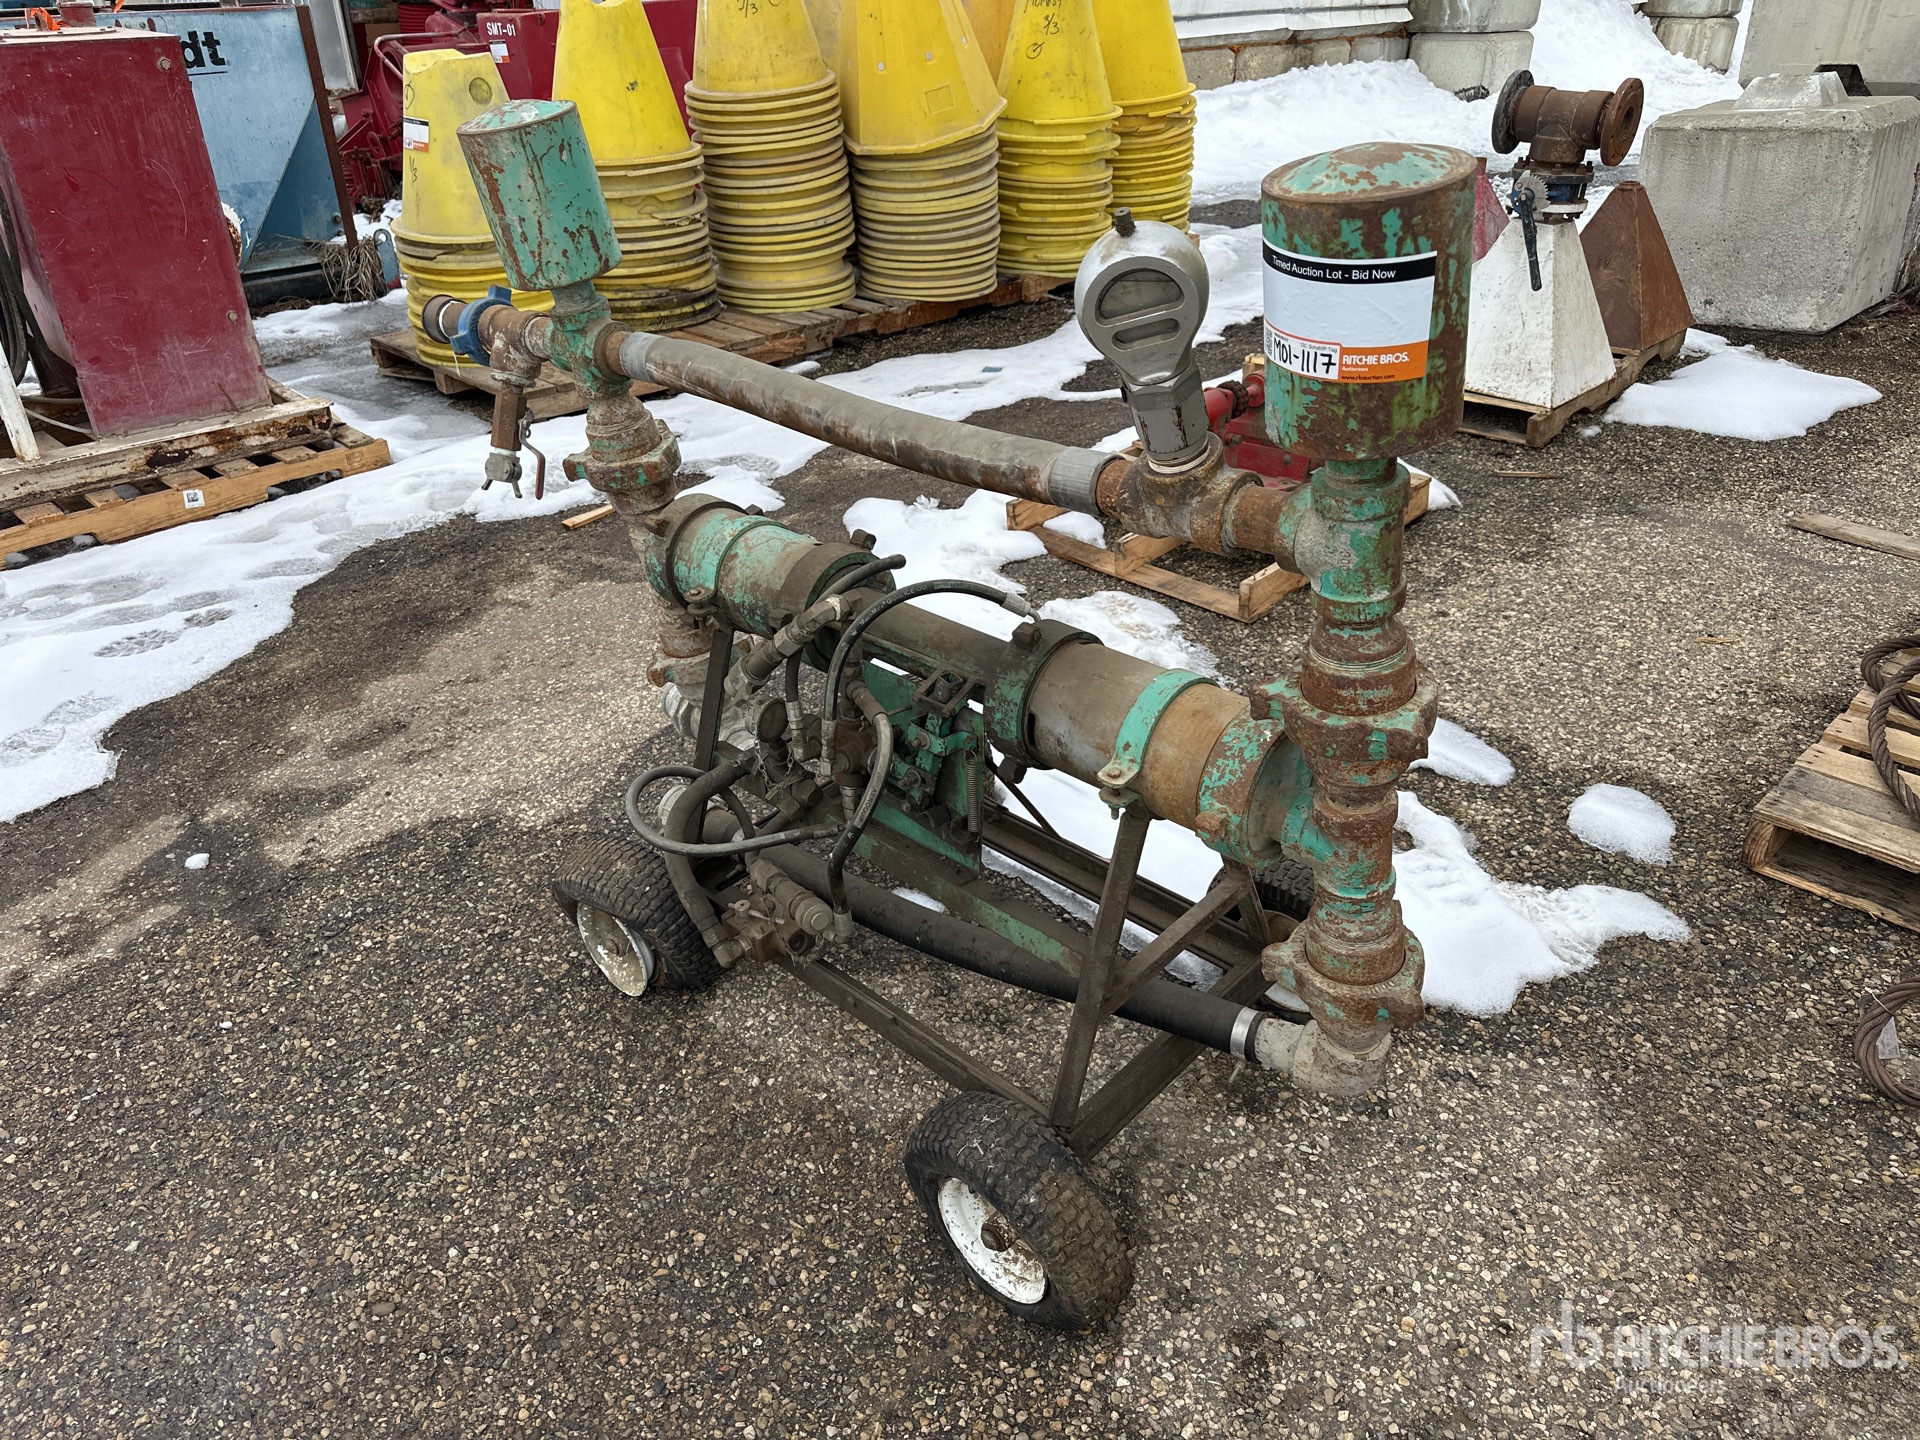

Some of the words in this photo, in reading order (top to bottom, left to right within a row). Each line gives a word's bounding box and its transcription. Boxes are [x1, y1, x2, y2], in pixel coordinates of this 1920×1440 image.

[486, 21, 516, 36] SMT-01
[1272, 254, 1291, 272] Timed
[1291, 263, 1324, 278] Auction
[1326, 268, 1342, 280] Lot
[1351, 269, 1369, 280] Bid
[1372, 269, 1396, 280] Now
[1342, 354, 1379, 365] RITCHIE
[1380, 351, 1410, 364] BROS.
